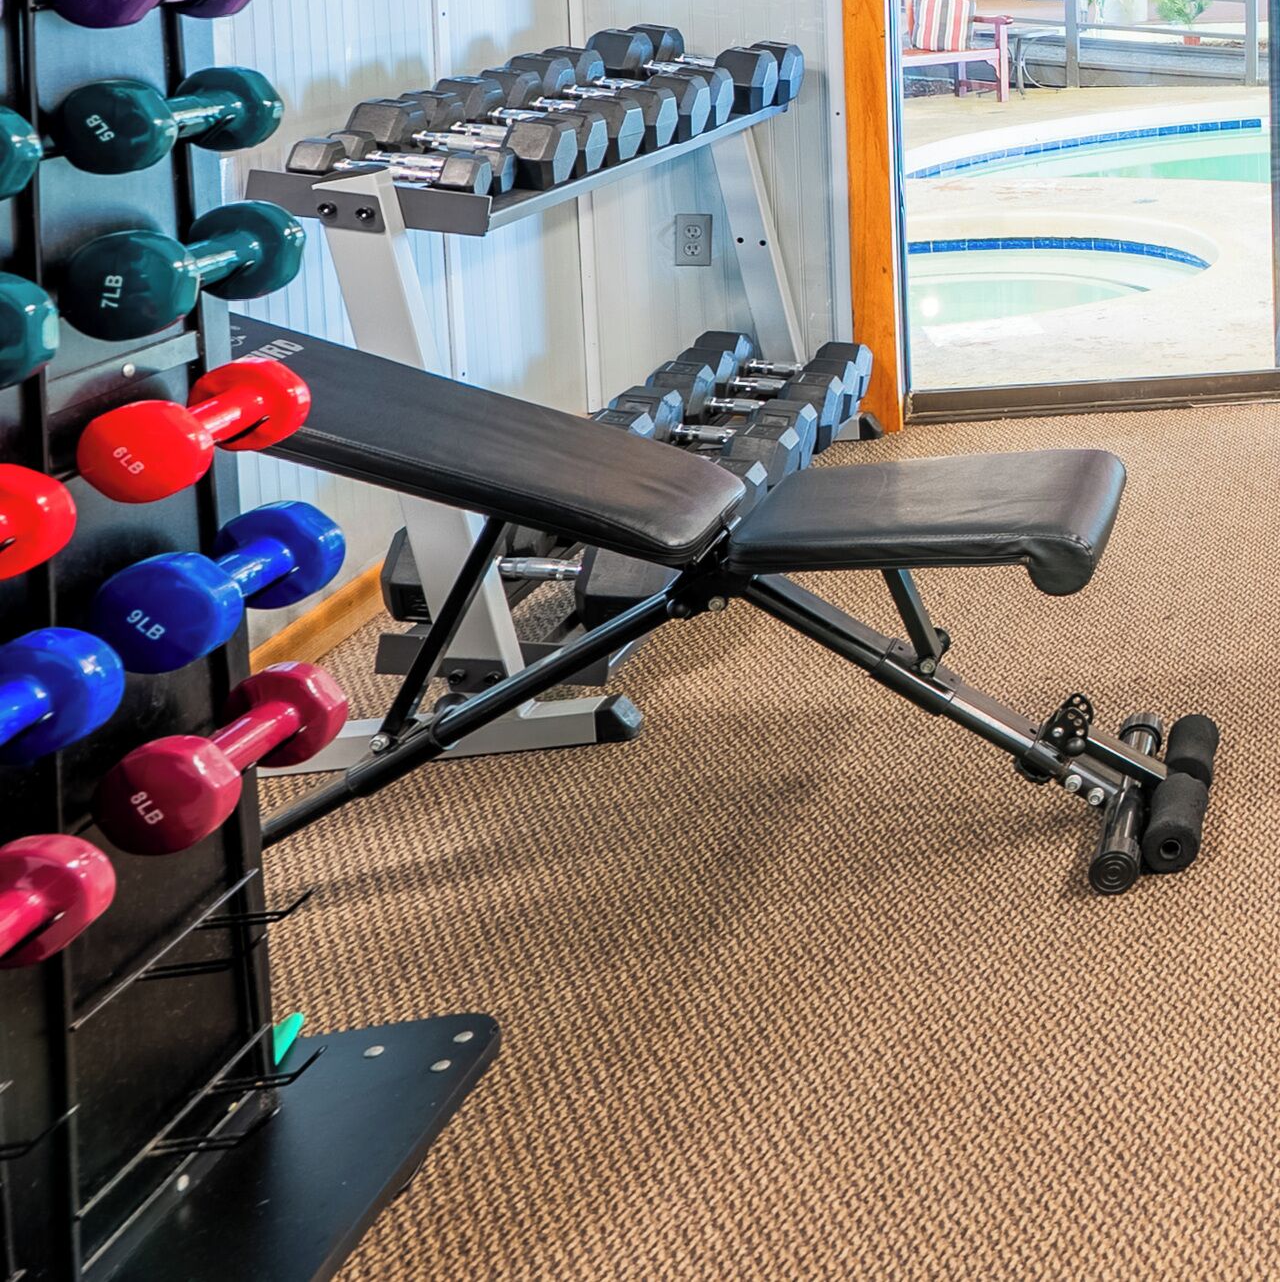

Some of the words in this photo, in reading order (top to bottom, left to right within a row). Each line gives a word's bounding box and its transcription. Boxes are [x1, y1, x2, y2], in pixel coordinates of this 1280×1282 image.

[86, 115, 115, 141] 5LB
[101, 275, 123, 308] 7LB
[113, 447, 144, 474] 6LB
[127, 609, 165, 639] 9LB
[131, 791, 164, 824] 8LB
